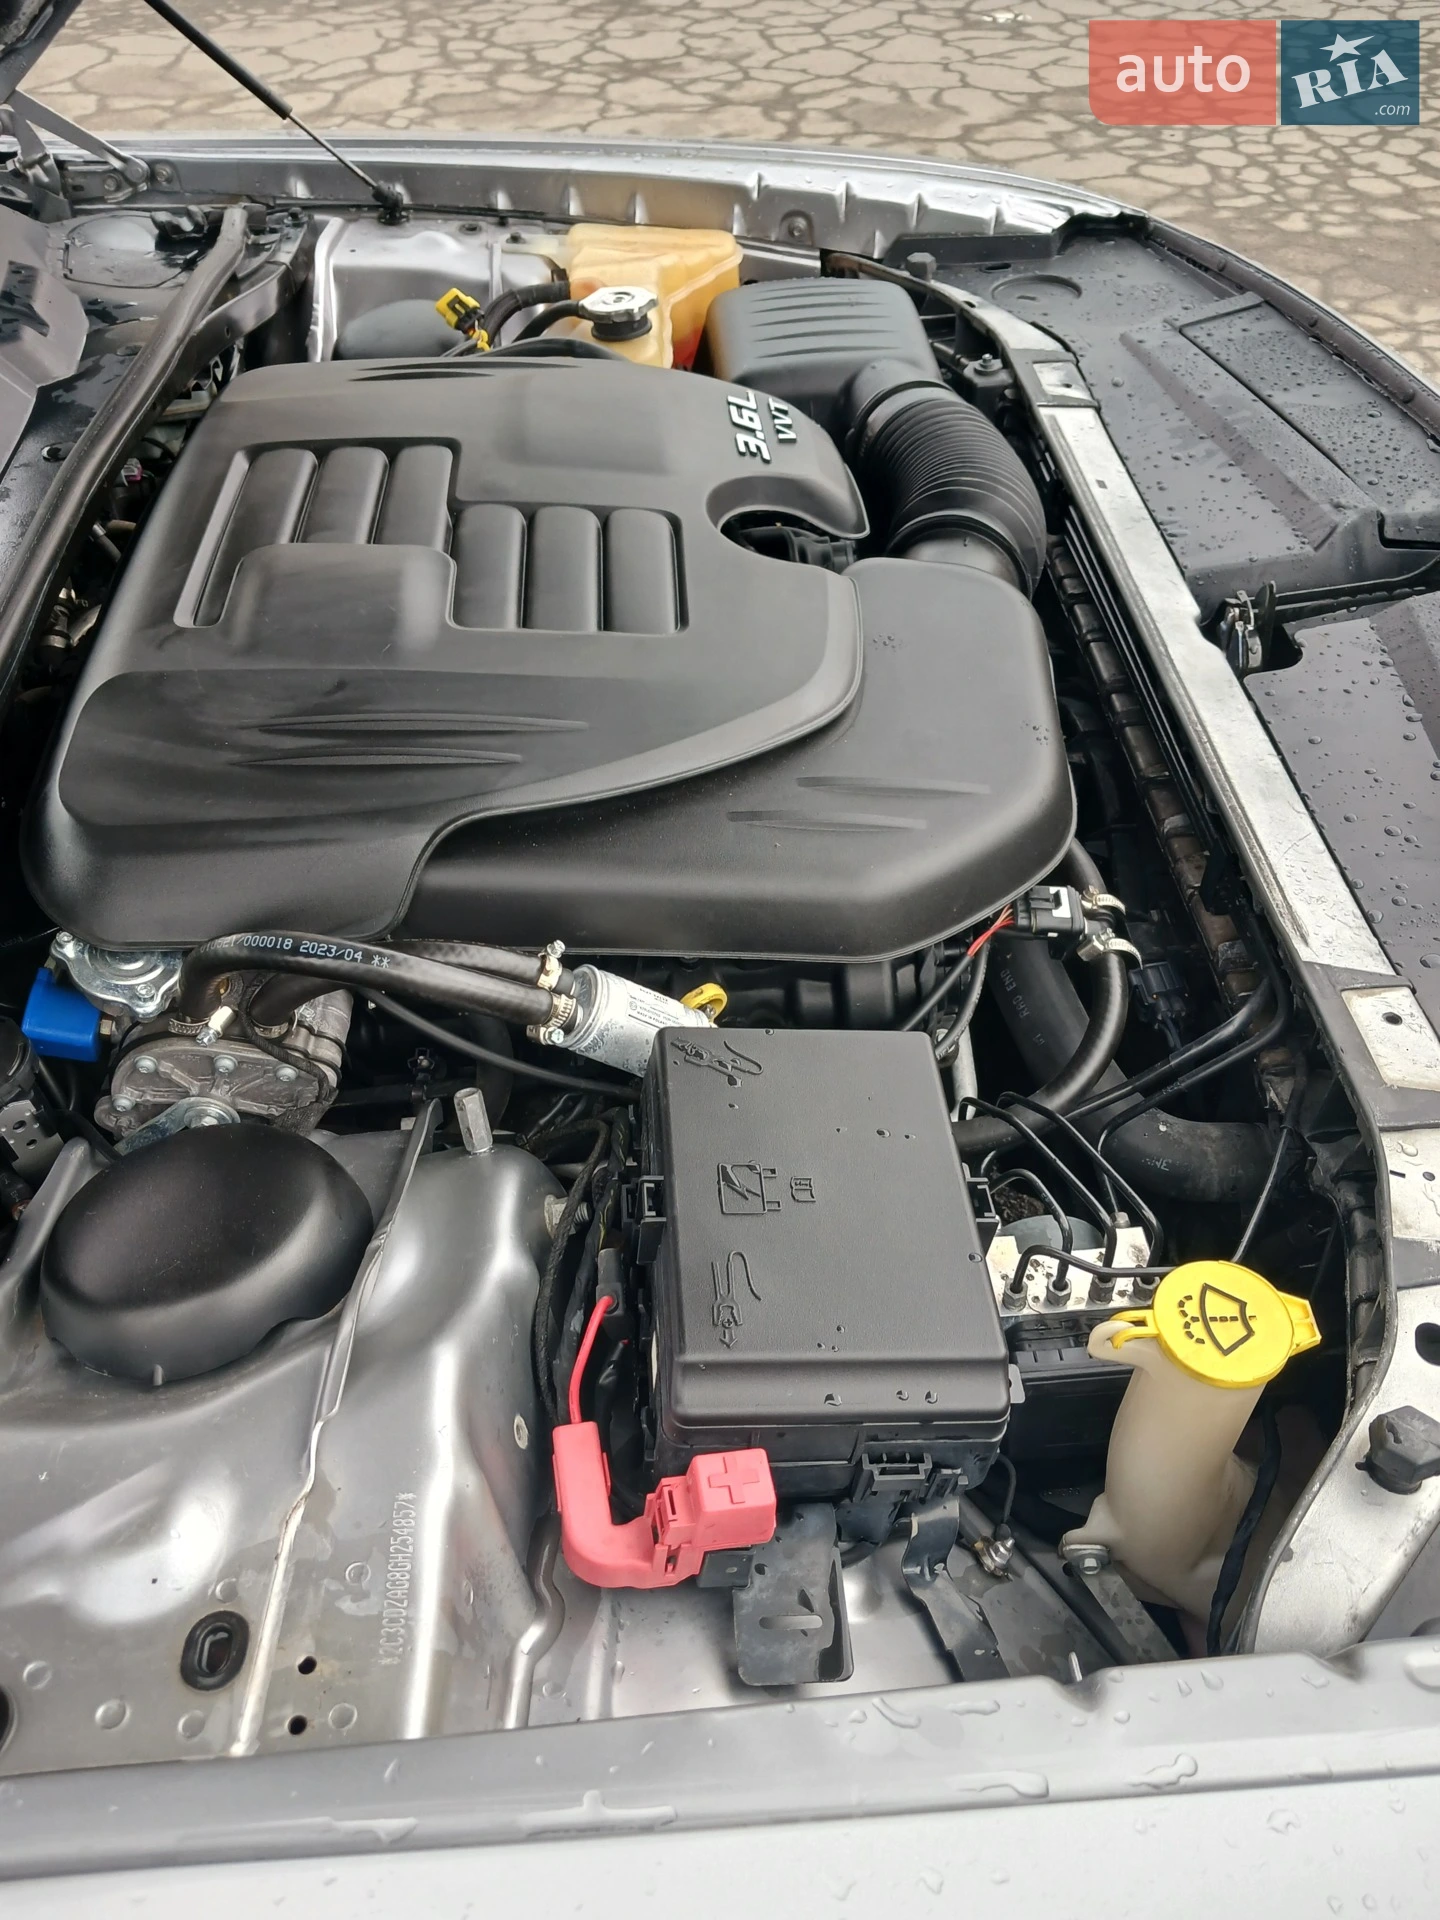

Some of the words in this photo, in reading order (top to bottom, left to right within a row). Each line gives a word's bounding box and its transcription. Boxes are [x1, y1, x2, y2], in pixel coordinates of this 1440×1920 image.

[726, 390, 772, 464] 3.6L
[768, 397, 797, 443] VVT
[299, 940, 363, 963] 2023/04
